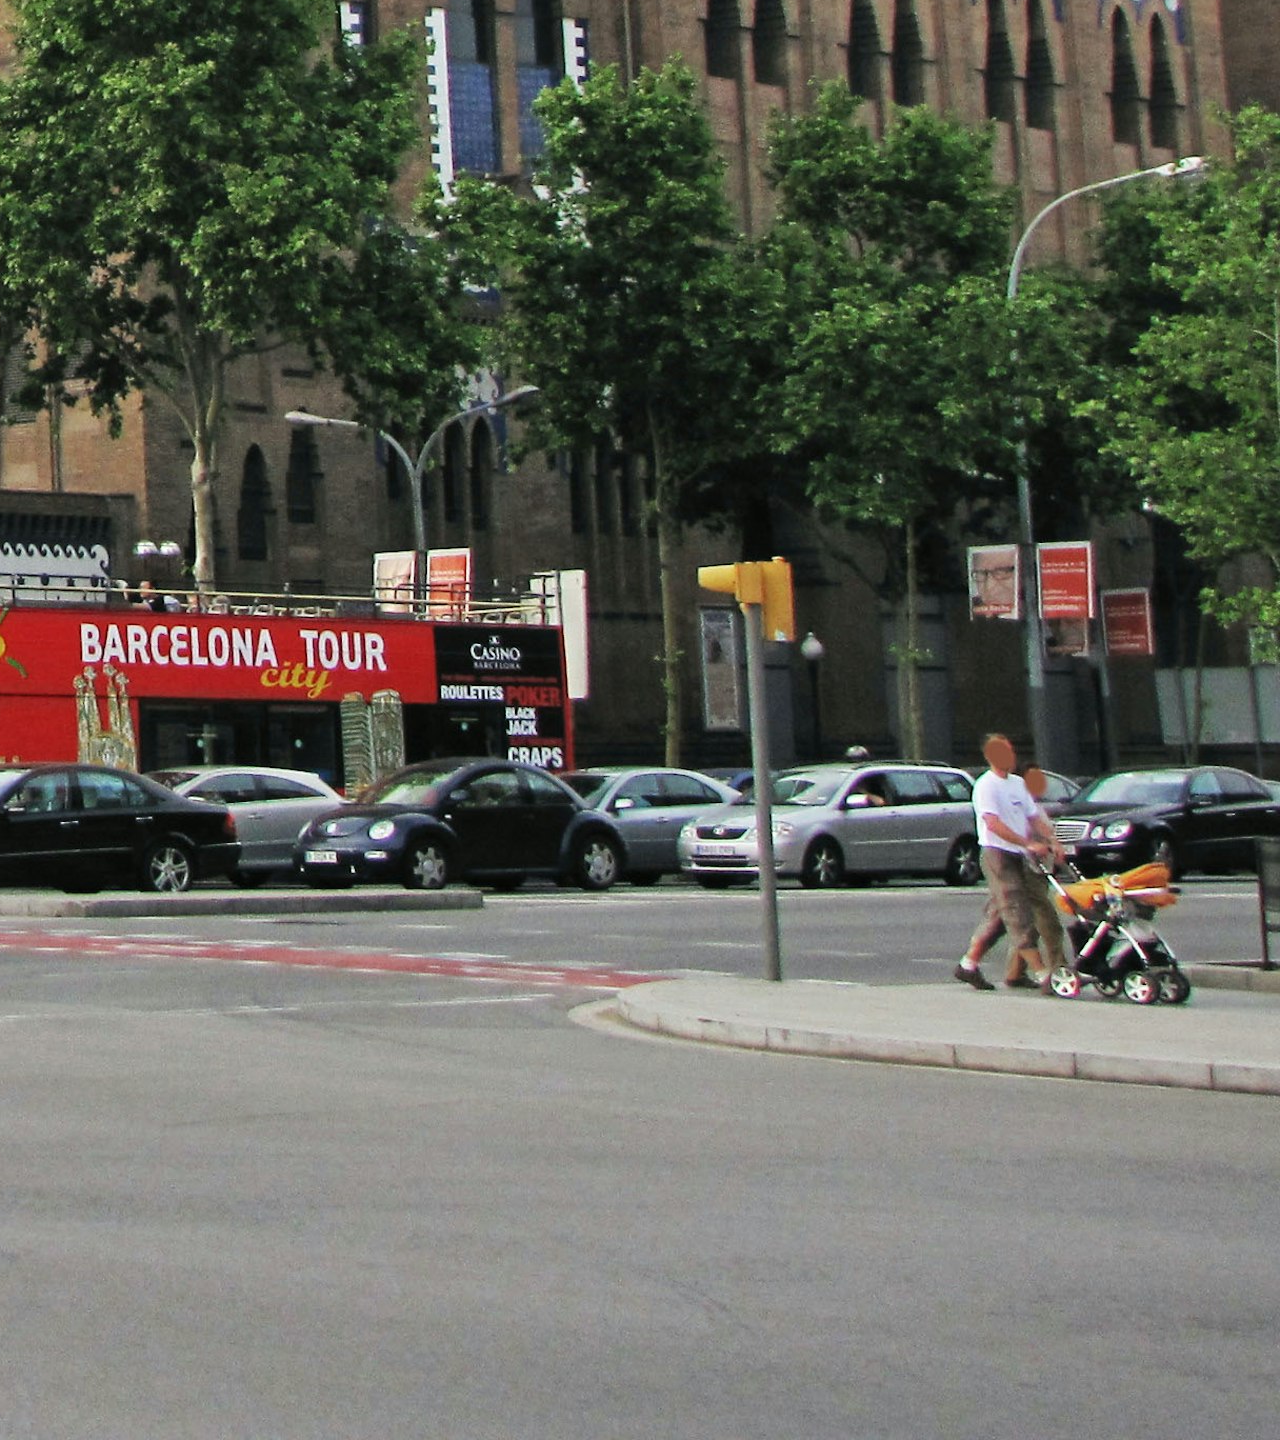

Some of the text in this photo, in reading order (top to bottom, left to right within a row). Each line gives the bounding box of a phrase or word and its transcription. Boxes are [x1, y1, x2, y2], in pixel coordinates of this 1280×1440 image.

[80, 623, 387, 671] BARCELONA TOUR
[470, 643, 520, 661] CASINO
[260, 662, 333, 698] city
[440, 685, 561, 707] ROULETTES POKER
[505, 707, 536, 719] BLACK
[506, 720, 538, 735] JACK
[507, 747, 563, 768] CRAPS
